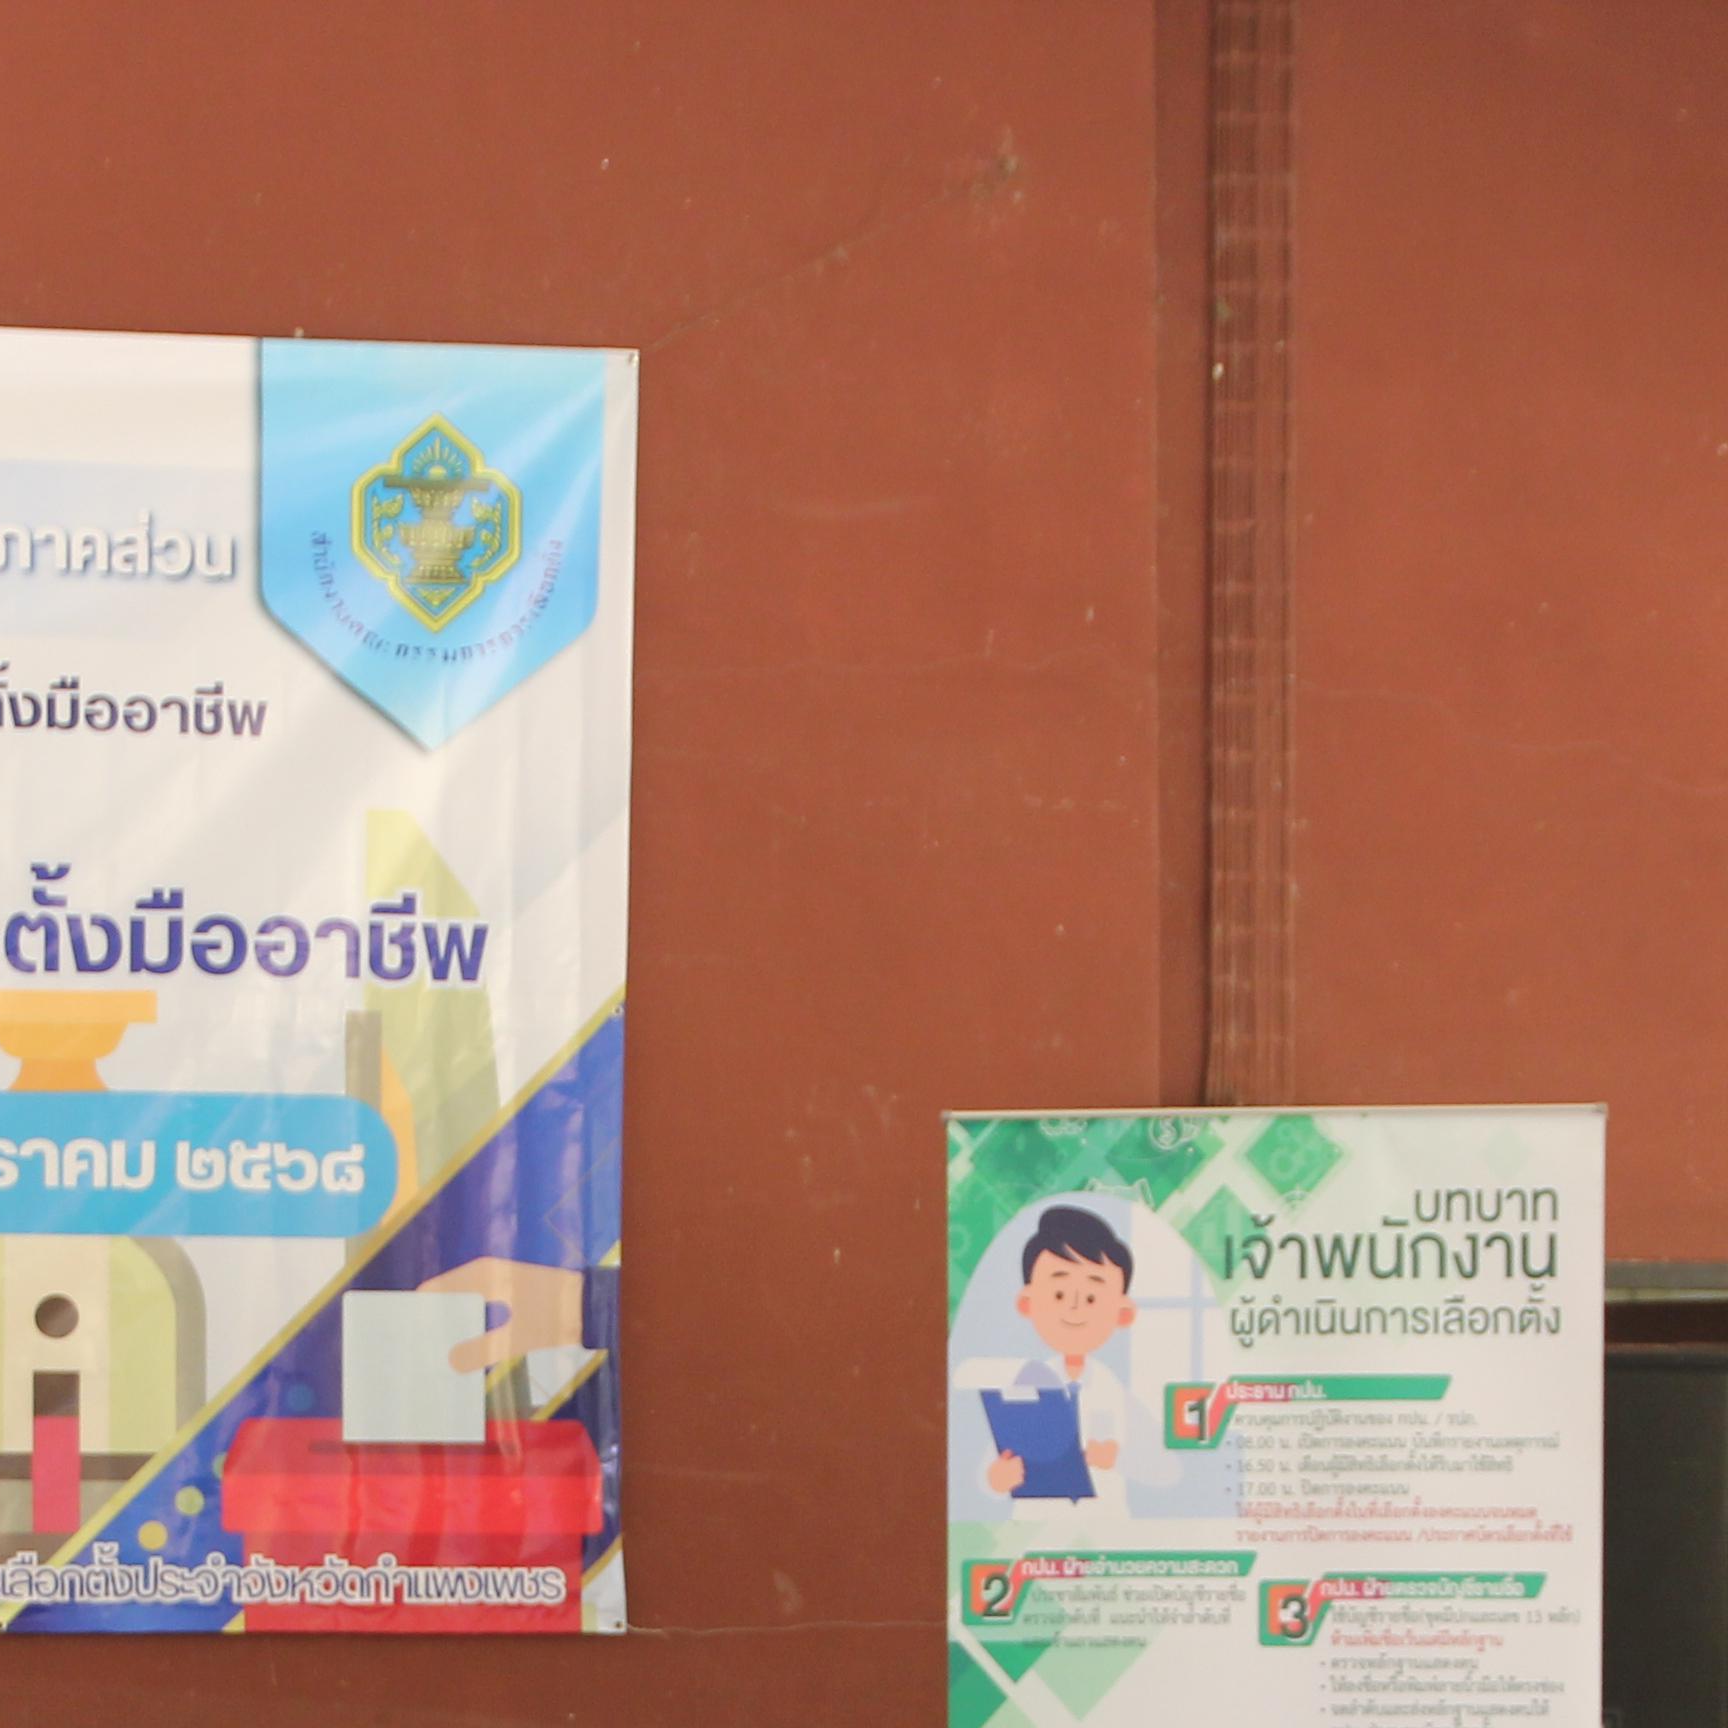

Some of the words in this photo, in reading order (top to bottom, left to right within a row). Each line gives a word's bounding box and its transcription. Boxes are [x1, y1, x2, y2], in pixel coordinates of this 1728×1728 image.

[173, 1139, 365, 1194] ๒๕๖๘
[1413, 1186, 1559, 1222] บทบาท
[1223, 1213, 1558, 1280] เจ้าพนักงาน
[1229, 1285, 1562, 1348] ผู้ดำเนินการเลือกตั้ง
[1188, 1396, 1209, 1443] 1
[981, 1571, 1012, 1618] 2
[1280, 1595, 1310, 1640] 3
